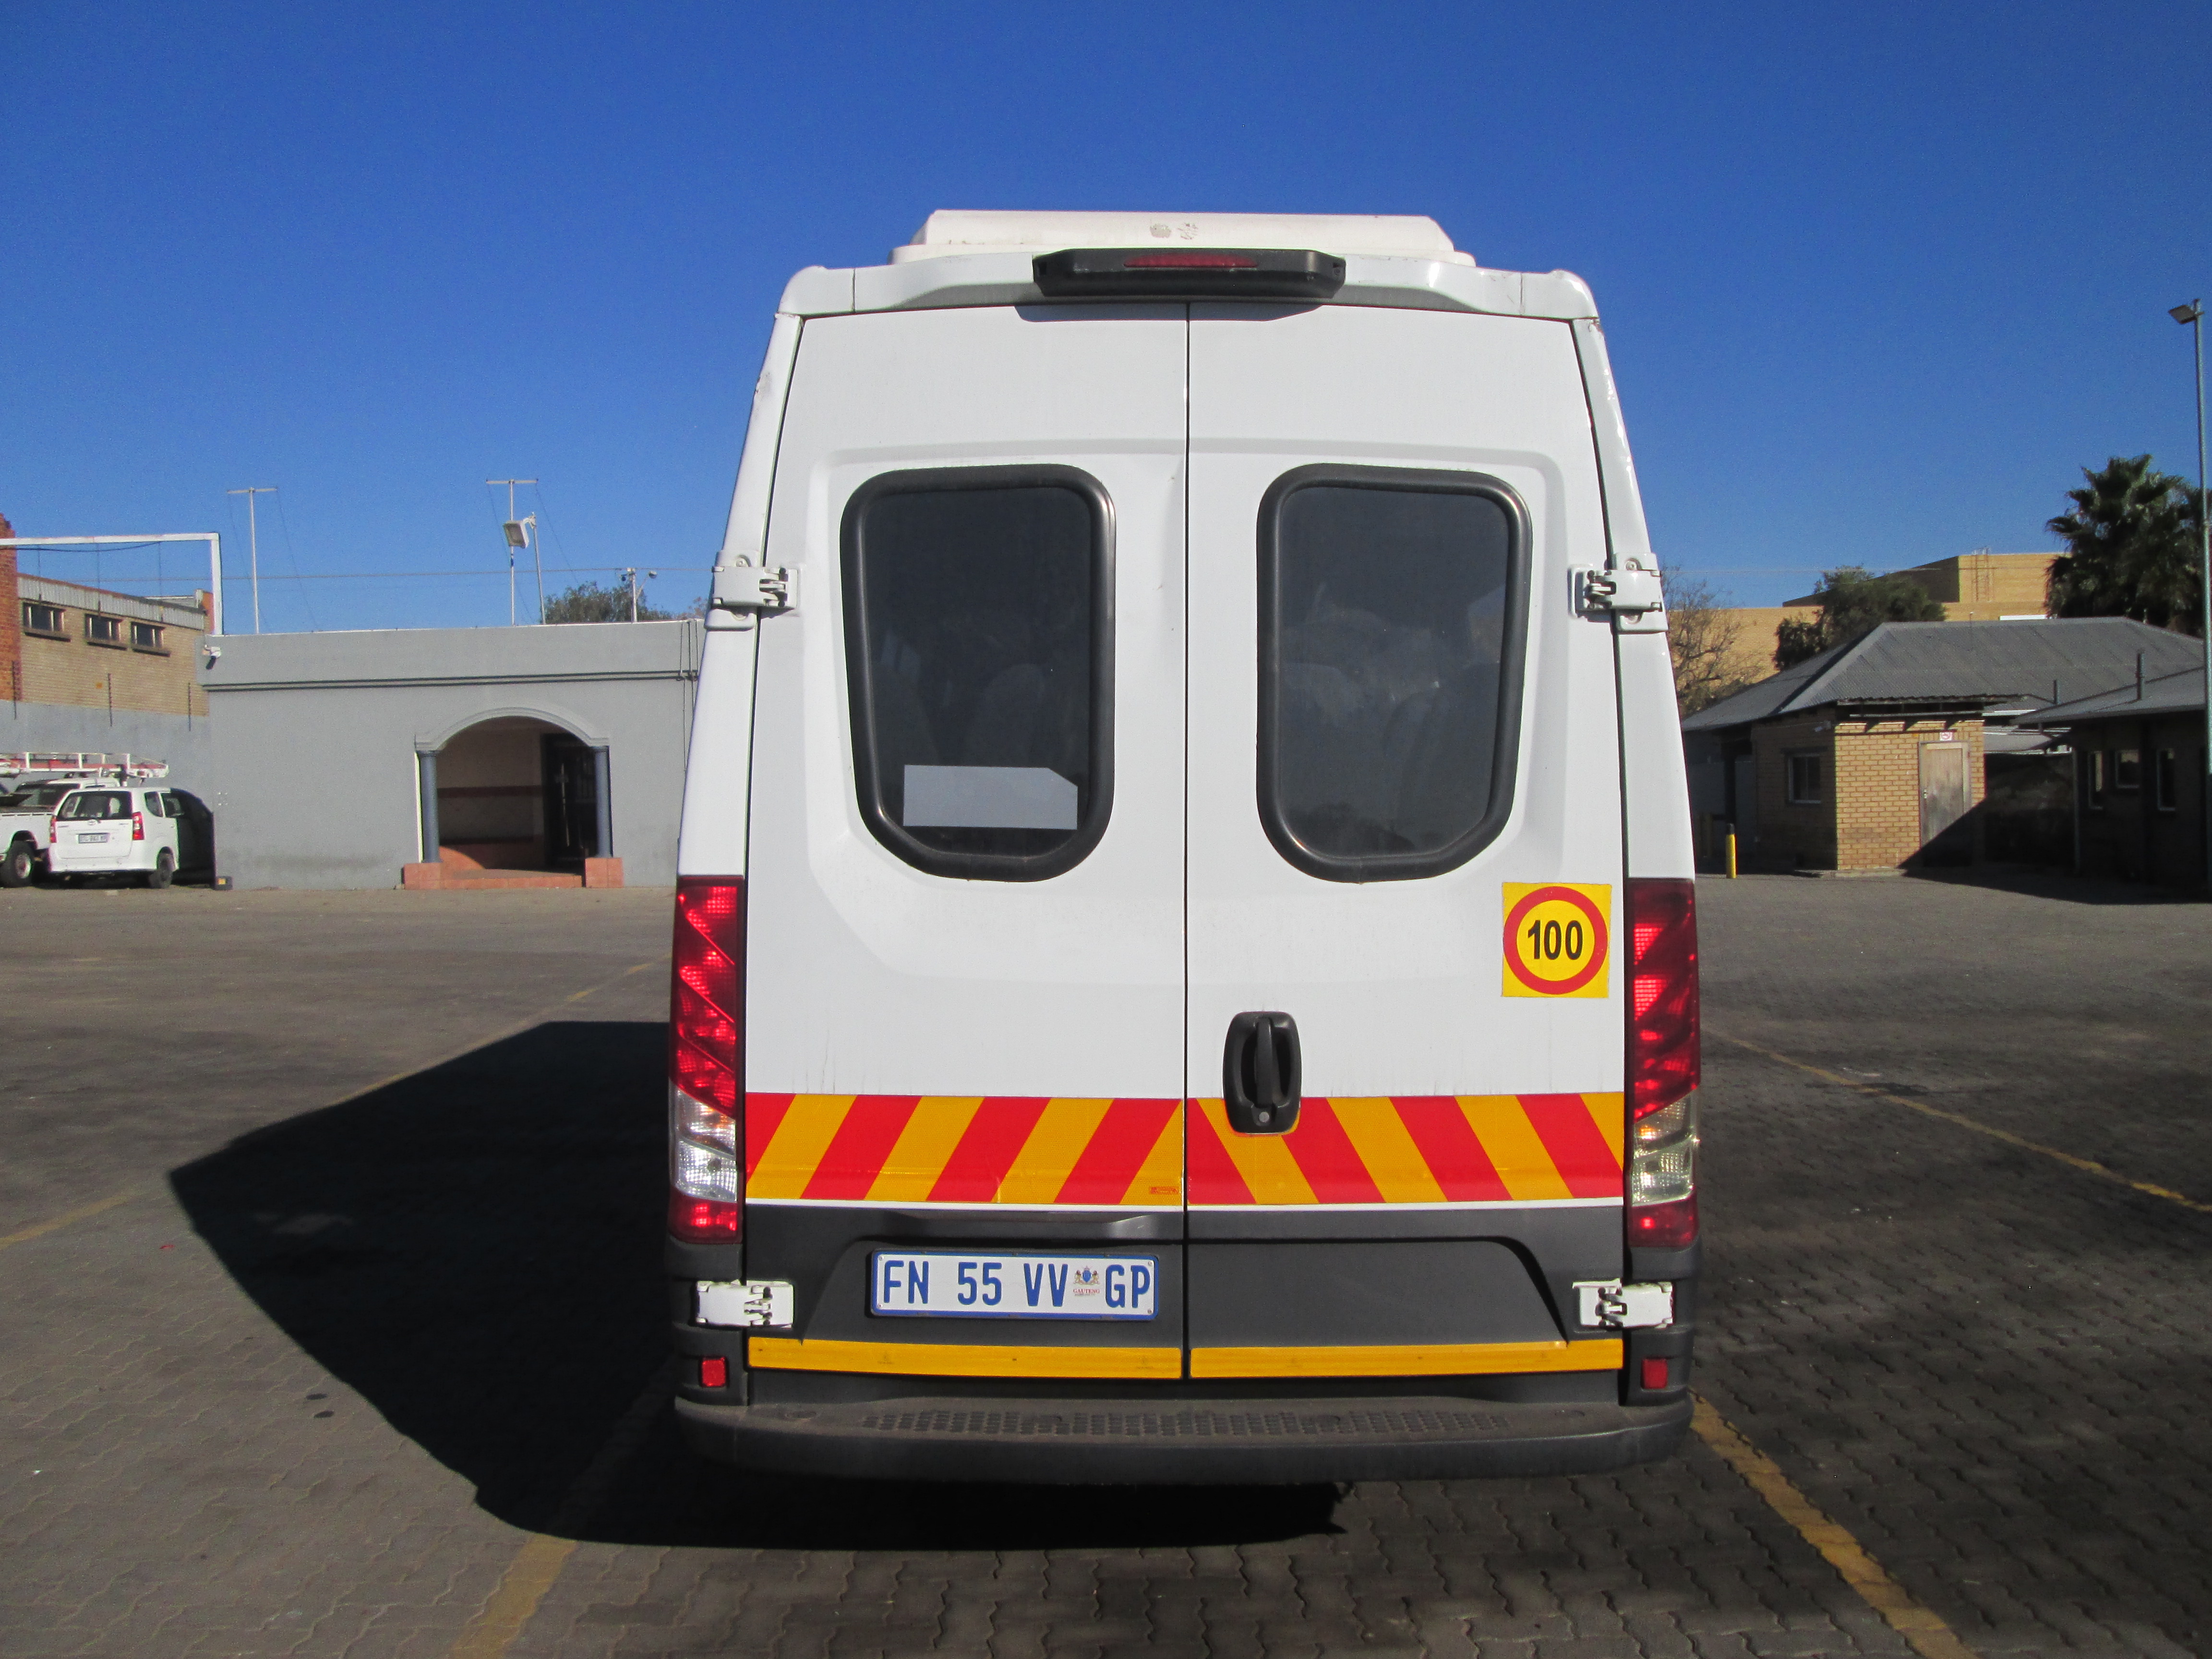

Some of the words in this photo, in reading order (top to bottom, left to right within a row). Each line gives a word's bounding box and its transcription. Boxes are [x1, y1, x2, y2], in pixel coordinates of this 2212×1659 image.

[1527, 919, 1583, 961] 100
[884, 1260, 929, 1304] FN
[957, 1262, 1002, 1305] 55
[1023, 1262, 1069, 1307] VV
[1105, 1264, 1151, 1308] GP
